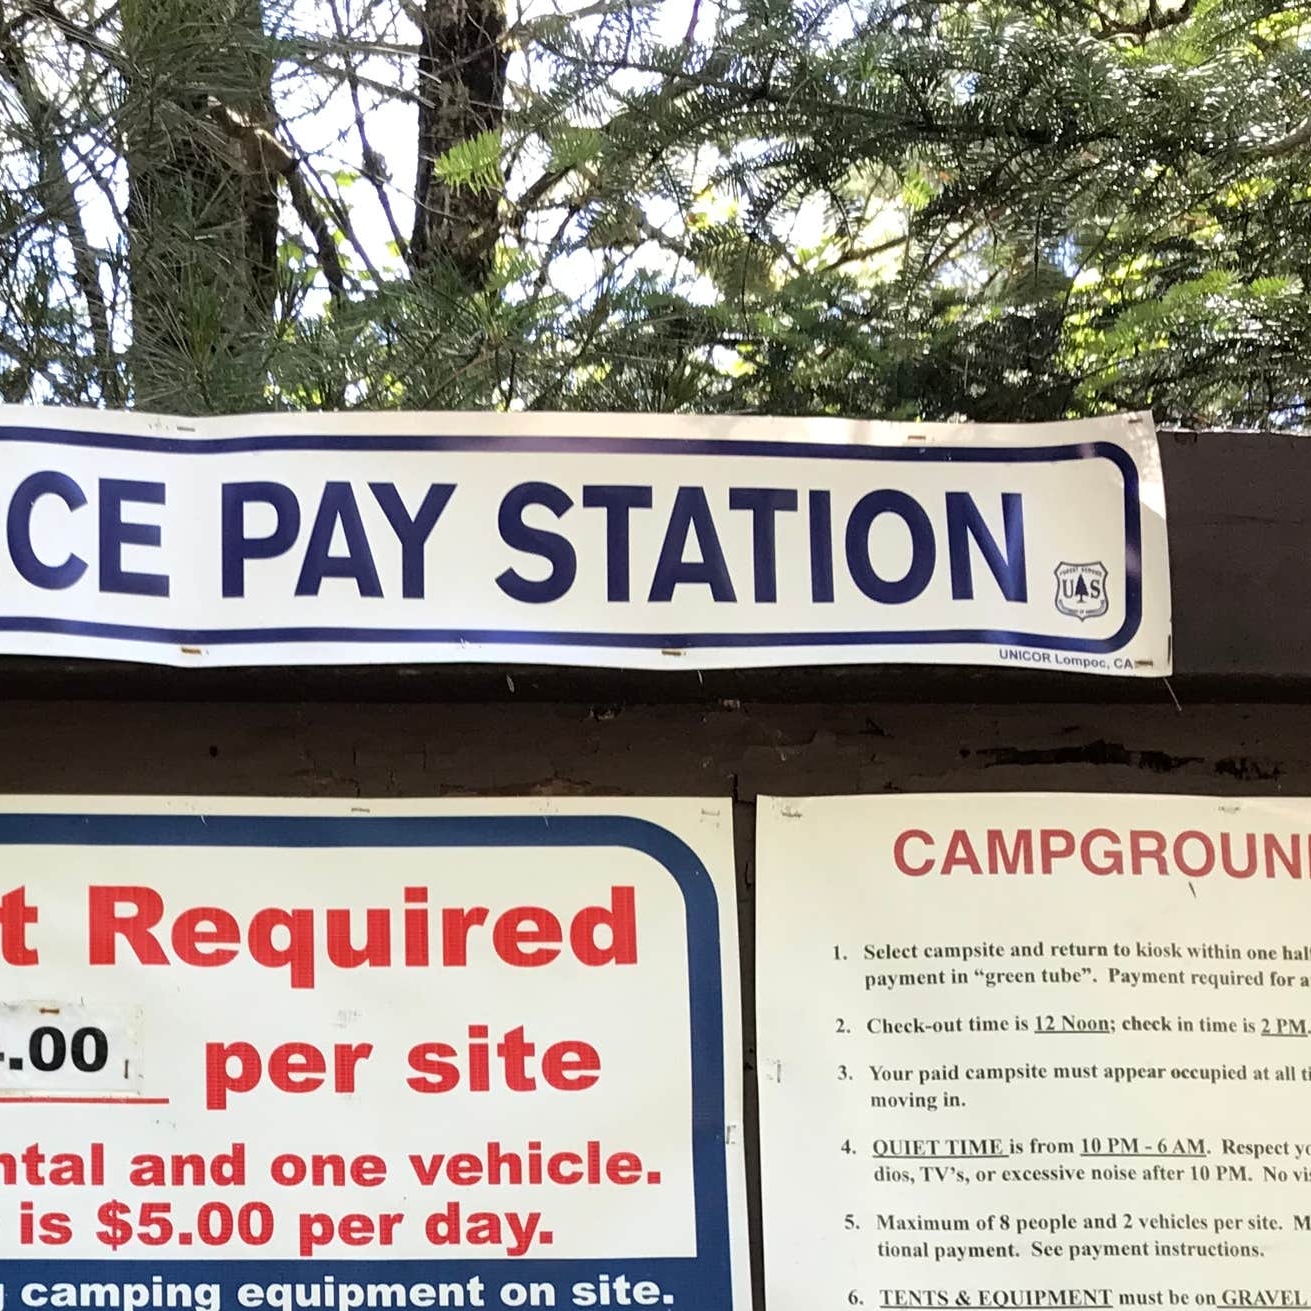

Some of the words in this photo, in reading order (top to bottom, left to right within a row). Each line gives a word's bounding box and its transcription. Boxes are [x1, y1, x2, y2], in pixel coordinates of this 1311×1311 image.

[222, 481, 457, 599] PAY
[495, 481, 1027, 605] STATION
[999, 649, 1052, 665] UNICOR
[1055, 654, 1111, 671] Lompoc,
[1113, 658, 1134, 670] CA
[894, 828, 1311, 879] CAMPGROUN
[89, 886, 637, 988] Required
[833, 944, 848, 961] 1.
[863, 943, 918, 960] Select
[923, 941, 1005, 962] campsite
[1010, 941, 1045, 957] and
[1050, 942, 1109, 957] return
[1113, 942, 1131, 957] to
[1135, 941, 1183, 958] kiosk
[1186, 943, 1242, 960] within
[1246, 948, 1278, 961] one
[1281, 945, 1311, 961] hal
[836, 1017, 850, 1034] 2.
[866, 1017, 963, 1034] Check-out
[968, 1015, 1010, 1032] time
[1014, 1015, 1029, 1032] is
[1035, 1014, 1056, 1035] 12
[1061, 1014, 1116, 1035] Noon;
[1121, 1015, 1173, 1032] check
[1177, 1015, 1194, 1032] in
[1199, 1016, 1237, 1033] time
[1242, 1017, 1256, 1033] is
[1261, 1017, 1271, 1037] 2
[206, 1042, 372, 1110] per
[408, 1025, 600, 1093] site
[130, 1143, 245, 1186] and
[271, 1154, 386, 1187] one
[410, 1141, 661, 1186] vehicle.
[21, 1202, 72, 1244] is
[97, 1200, 273, 1249] $5.00
[300, 1213, 403, 1257] per
[426, 1202, 552, 1256] day.
[877, 1240, 929, 1258] tional
[934, 1243, 1020, 1262] payment.
[1031, 1240, 1064, 1257] See
[1068, 1241, 1149, 1262] payment
[1154, 1240, 1265, 1257] instructions.
[501, 1283, 555, 1306] on
[573, 1275, 673, 1305] site.
